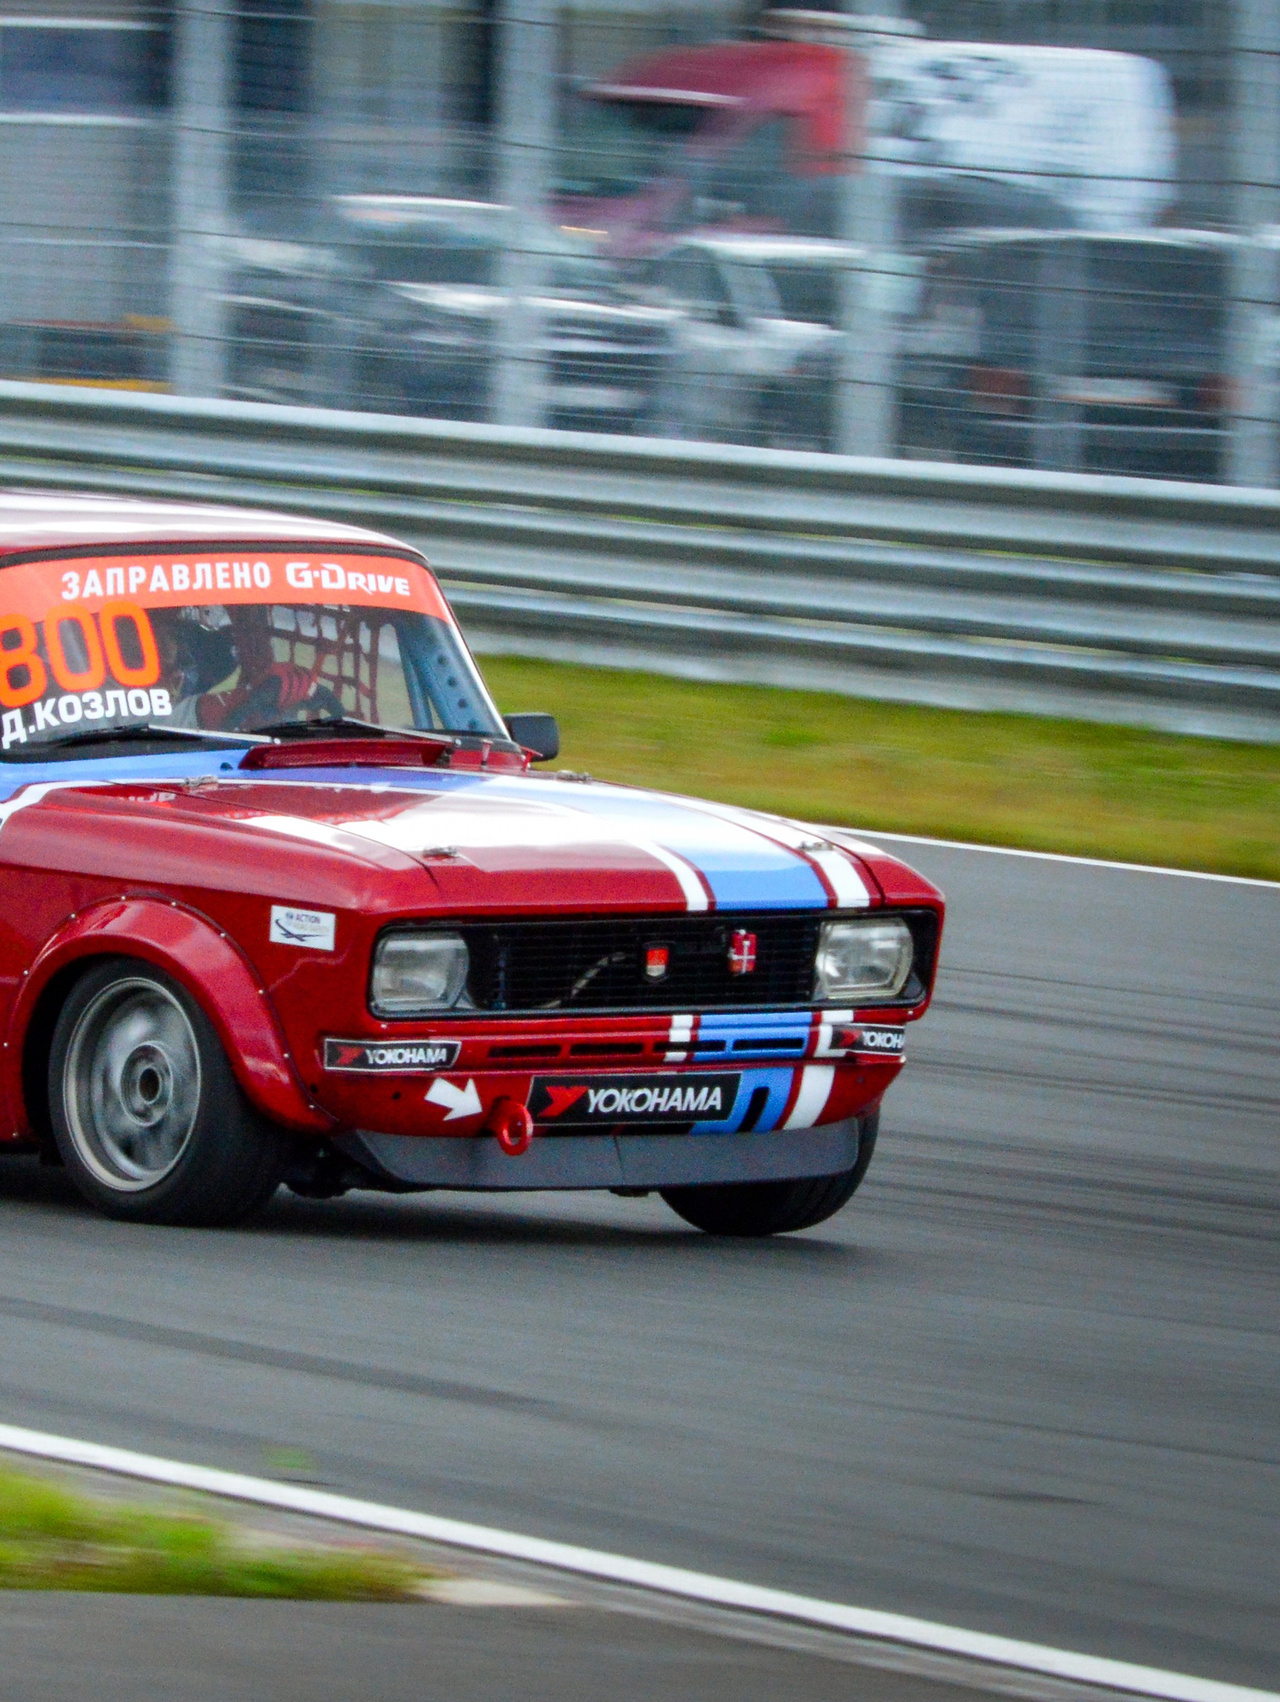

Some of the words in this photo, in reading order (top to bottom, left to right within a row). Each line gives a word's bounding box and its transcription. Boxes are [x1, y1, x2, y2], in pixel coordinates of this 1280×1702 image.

[61, 563, 270, 600] ЗАПРАВЛЕНО
[1, 689, 173, 750] Д.КОЗЛОВ
[295, 913, 321, 924] ACTION
[365, 1048, 447, 1064] YOKOHAMA
[587, 1087, 722, 1113] YOKOHAMA
